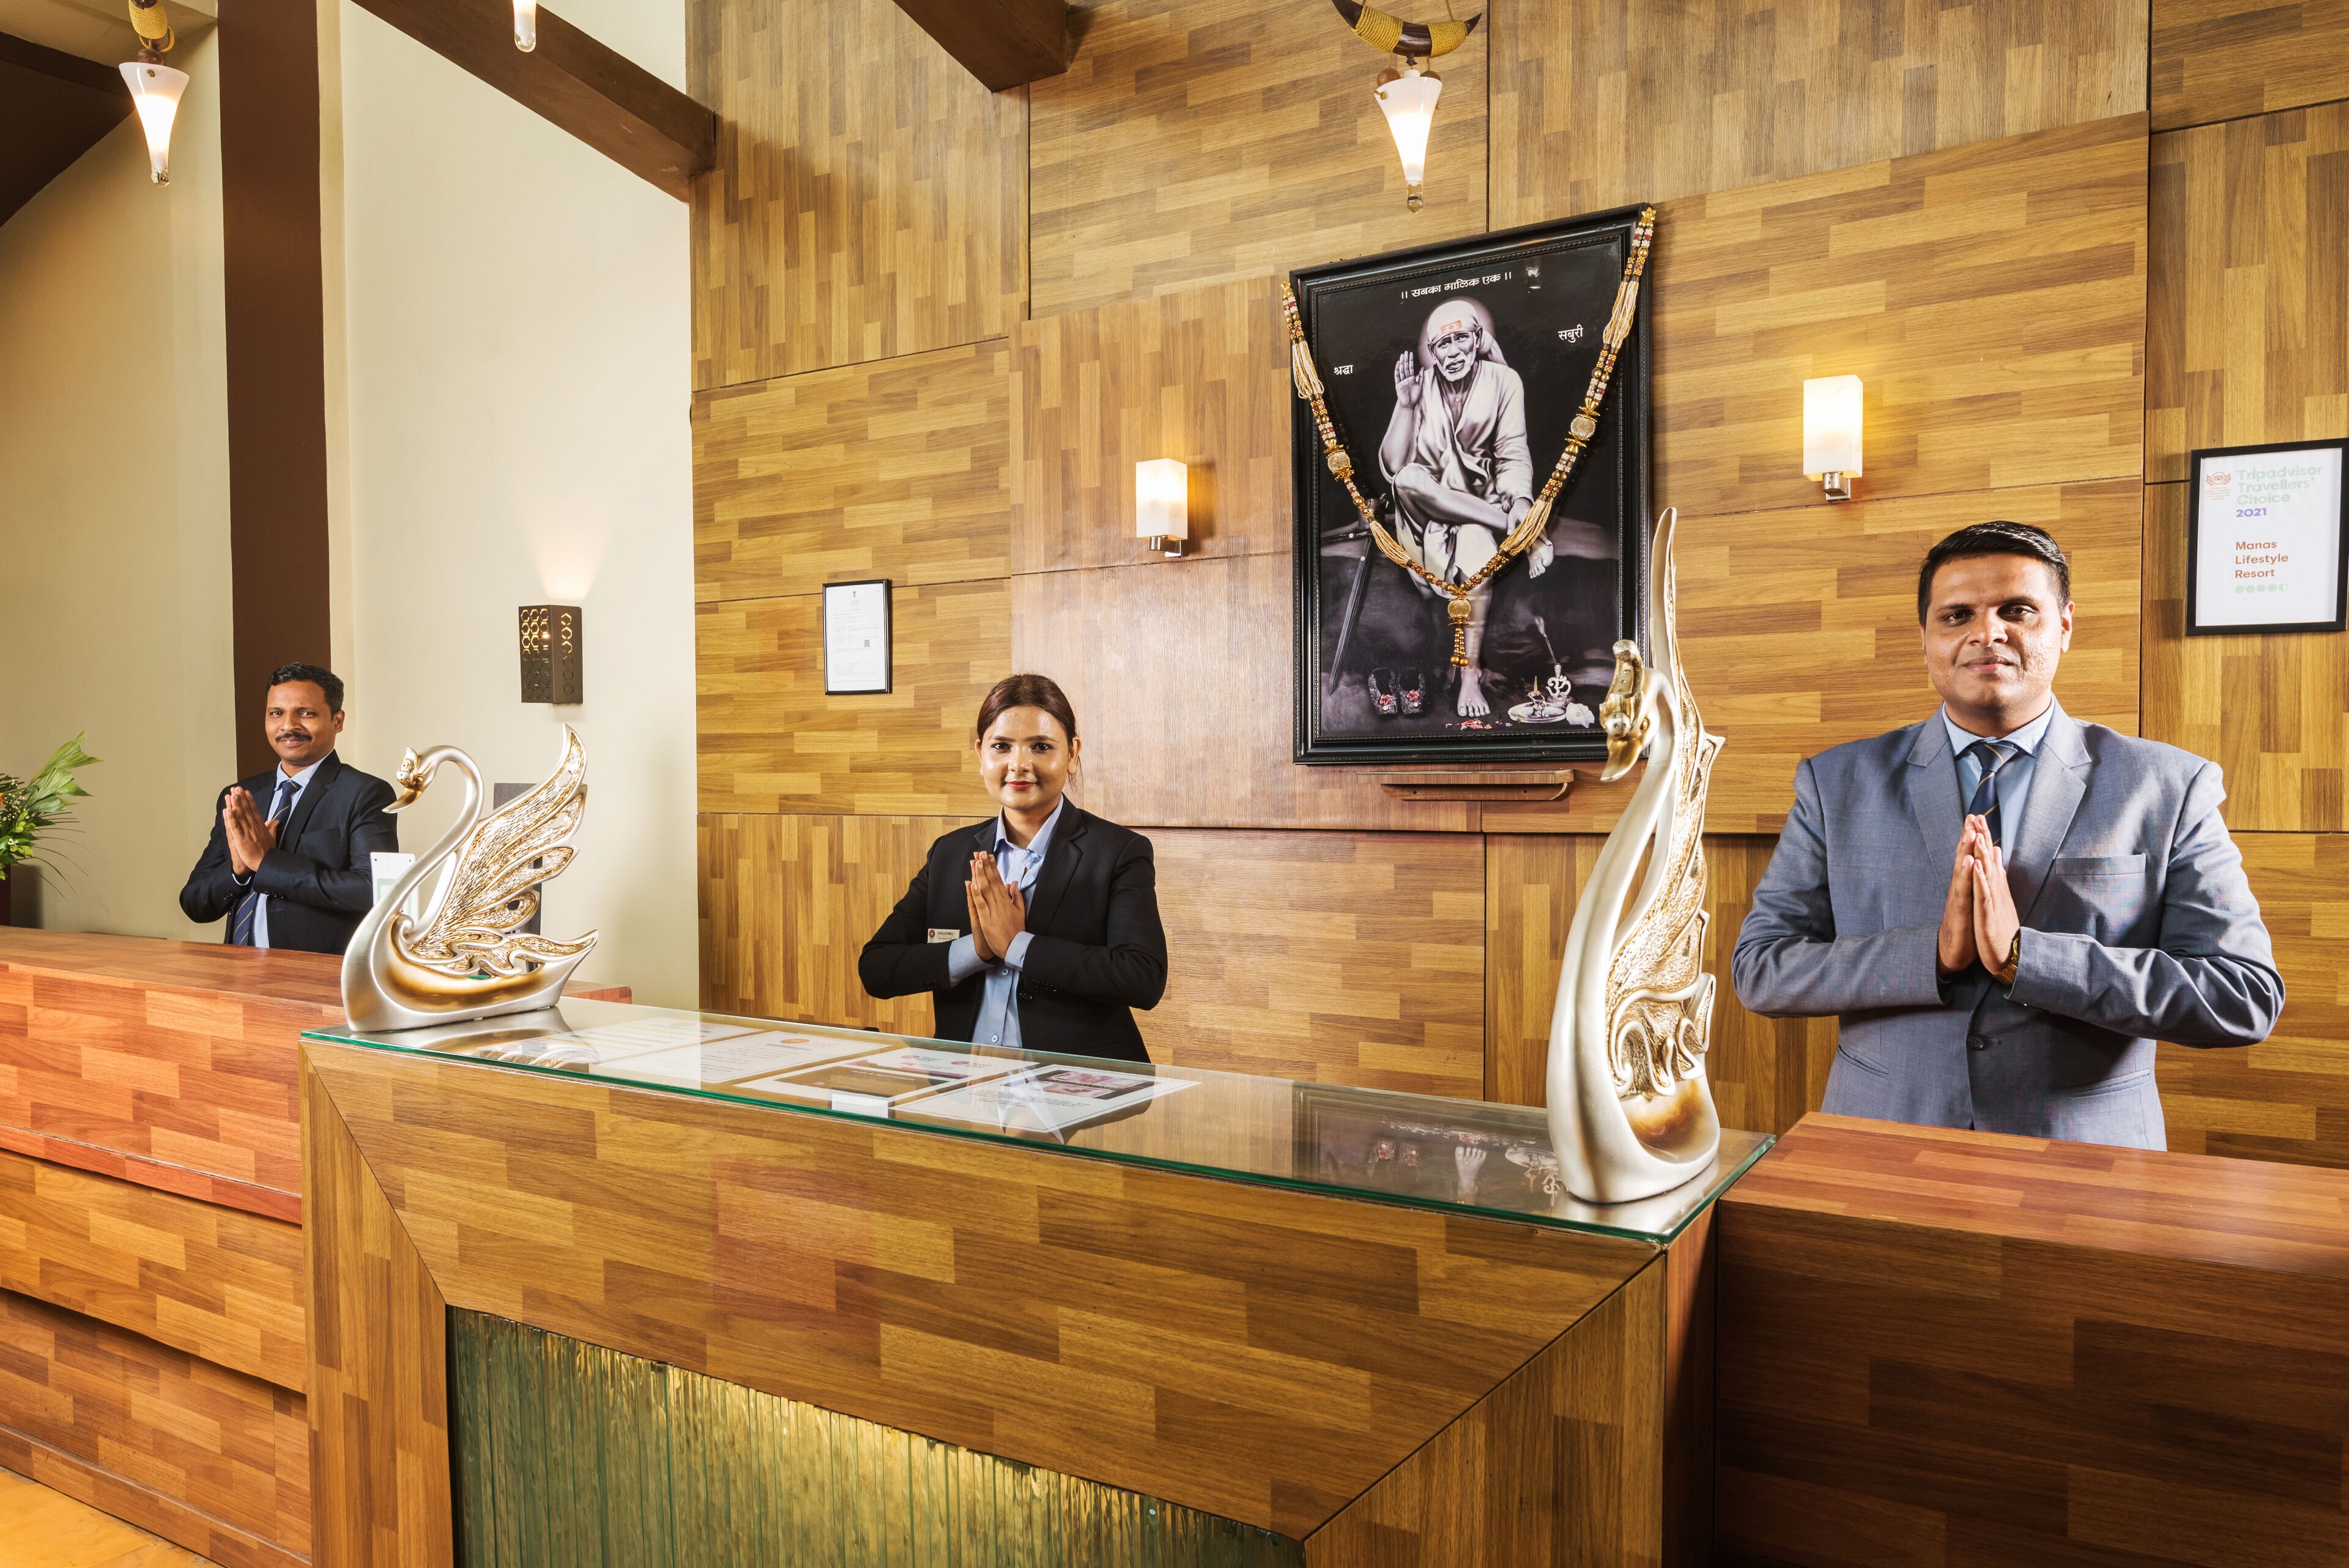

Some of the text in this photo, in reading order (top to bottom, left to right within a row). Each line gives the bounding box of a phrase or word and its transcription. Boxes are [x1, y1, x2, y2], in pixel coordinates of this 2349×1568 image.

[1411, 284, 1441, 297] सबका
[1444, 278, 1480, 291] मालिक
[1482, 273, 1501, 284] एक
[1557, 324, 1584, 343] सबुरी
[1334, 364, 1354, 376] श्रद्धा
[2236, 465, 2323, 482] Tripadvisor
[2236, 492, 2291, 505] Choice
[2236, 507, 2267, 518] 2021
[2235, 541, 2277, 550] Manas
[2235, 553, 2289, 565] Lifestyle
[2235, 568, 2276, 579] Resort
